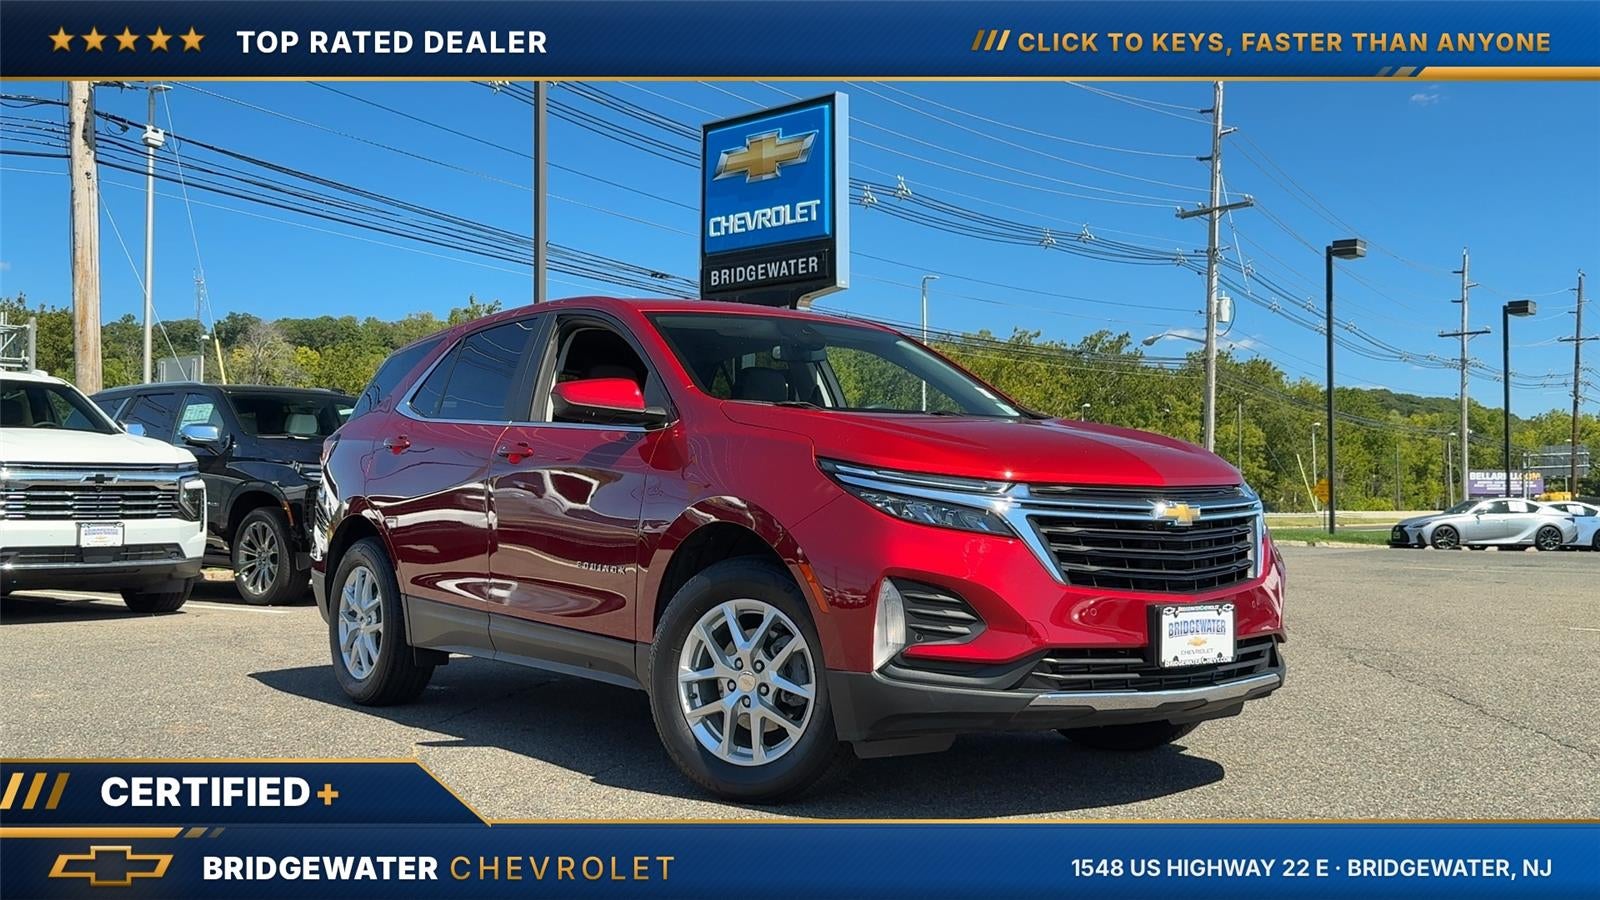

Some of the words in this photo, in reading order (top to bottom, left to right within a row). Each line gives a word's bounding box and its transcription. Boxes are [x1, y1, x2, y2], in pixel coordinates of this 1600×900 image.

[708, 199, 821, 237] CHEVROLET
[710, 256, 819, 286] BRIDGEWATER
[576, 561, 626, 575] EQUINOX
[1168, 619, 1226, 638] BRIDGEWATER
